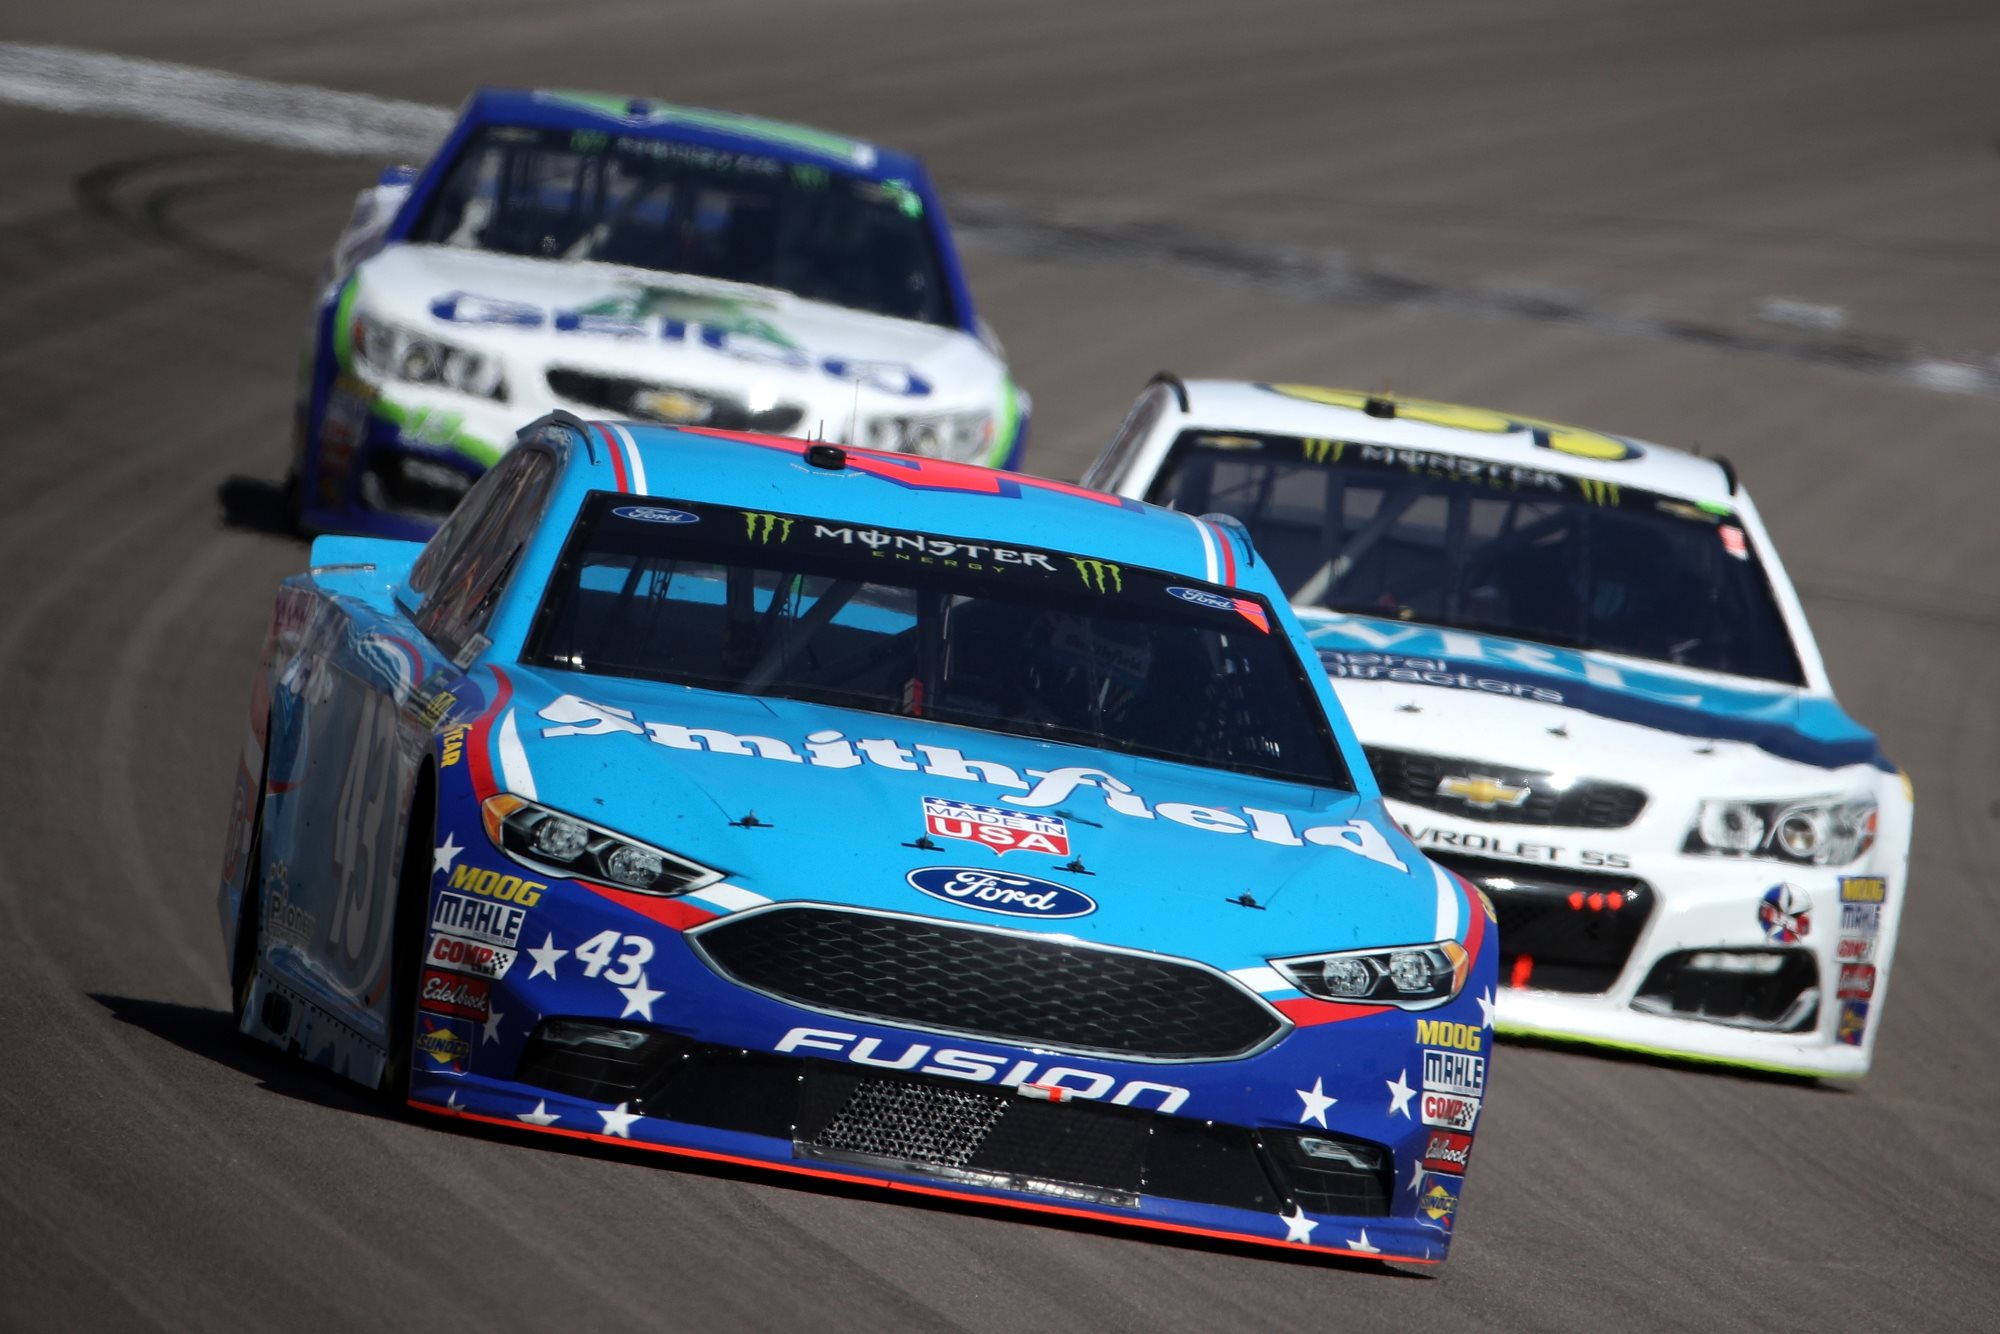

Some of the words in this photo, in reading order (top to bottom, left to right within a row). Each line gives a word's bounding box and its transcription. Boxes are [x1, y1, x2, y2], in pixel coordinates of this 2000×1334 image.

[814, 524, 1058, 571] MONSTER
[872, 550, 1005, 573] ENERGY
[536, 693, 1410, 874] Smithfield
[926, 805, 1023, 828] MADE
[1035, 822, 1065, 836] IN
[934, 817, 1062, 854] USA
[1402, 823, 1566, 862] VROLET
[1580, 848, 1631, 869] SS
[447, 863, 548, 908] MOOG
[943, 871, 1058, 910] Ford
[434, 893, 524, 940] MAHLE
[432, 937, 494, 966] COMP
[575, 929, 656, 986] 43
[422, 977, 488, 1012] Edelbrock
[416, 1033, 470, 1058] SUNOCO
[1416, 1019, 1482, 1052] MOOG
[1425, 1052, 1484, 1089] MAHLE
[1425, 1096, 1463, 1121] COMP
